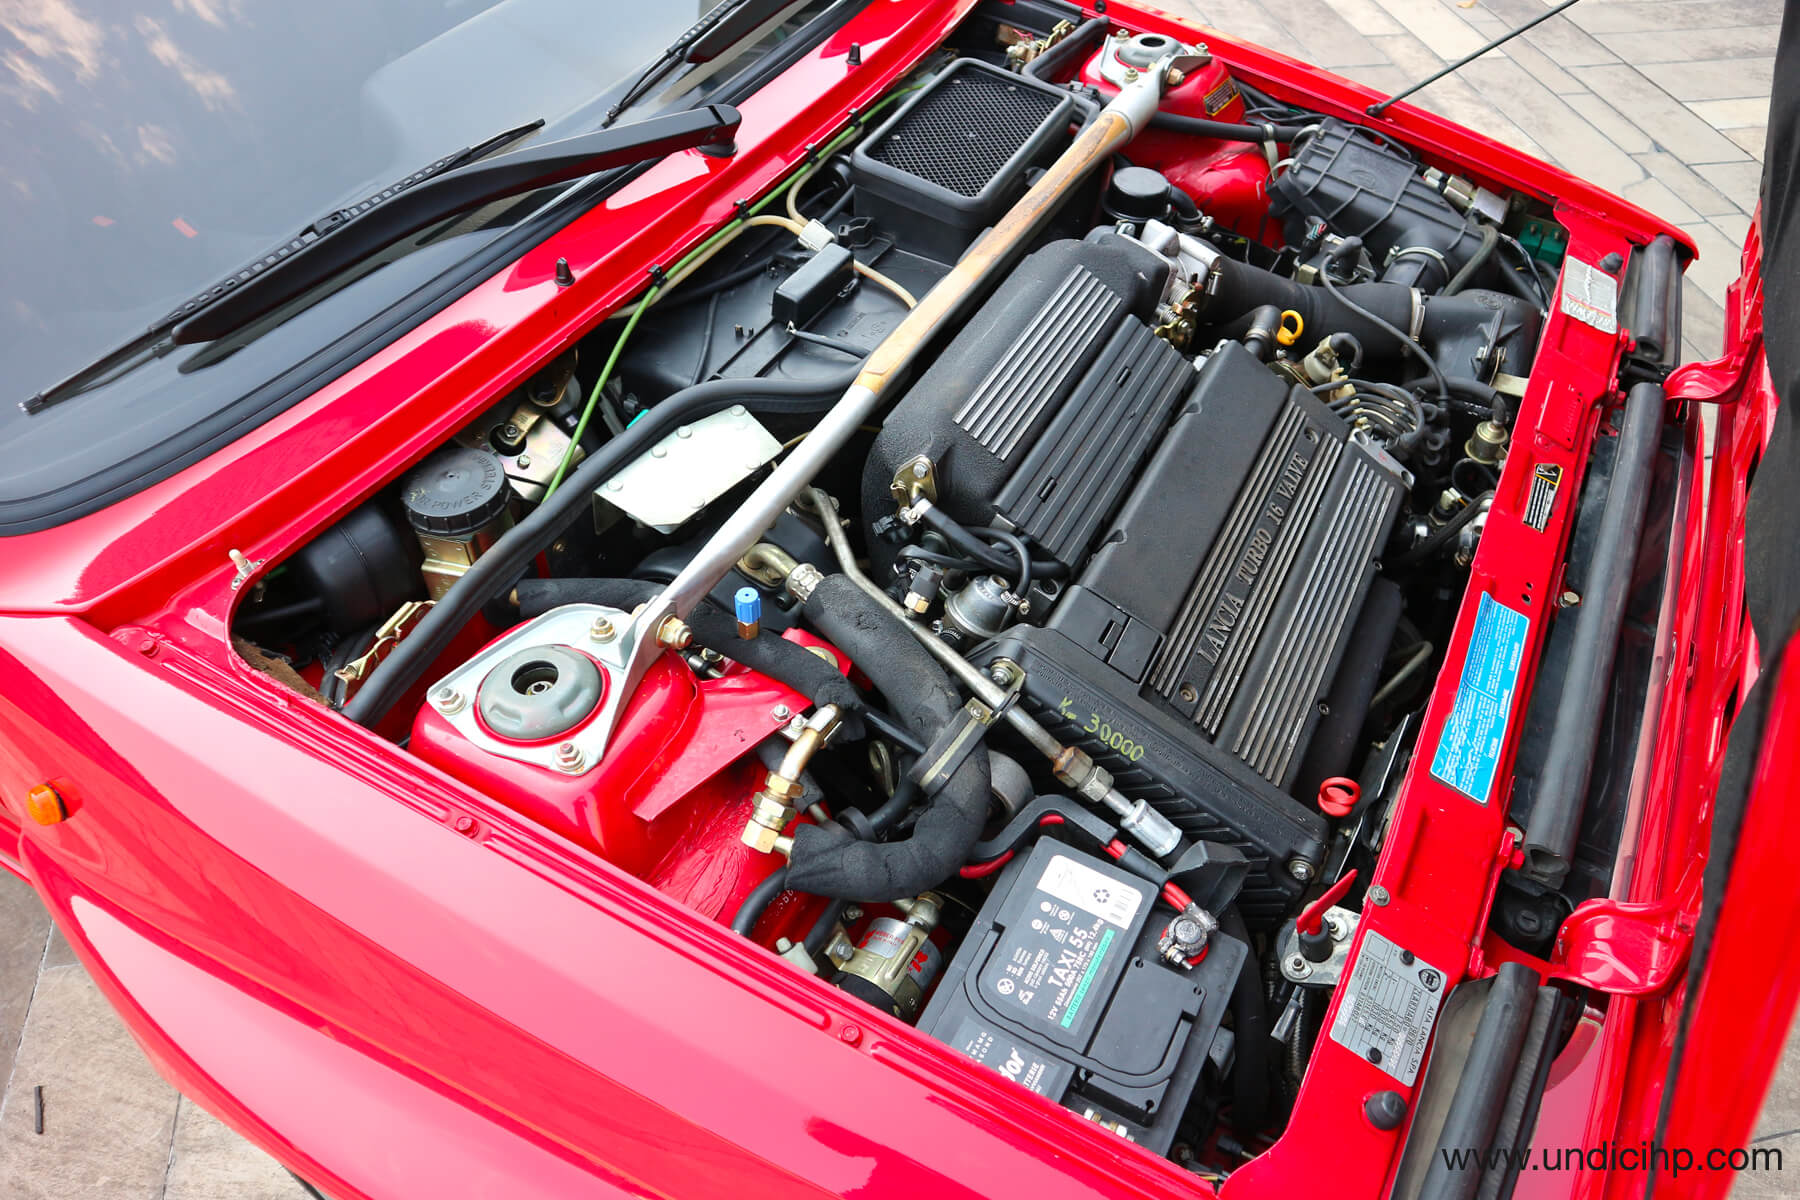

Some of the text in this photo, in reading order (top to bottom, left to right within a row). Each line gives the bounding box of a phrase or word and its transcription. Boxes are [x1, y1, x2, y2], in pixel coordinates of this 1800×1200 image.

[1197, 451, 1310, 666] LANCIA TURBO 16 VALVE
[1047, 949, 1078, 987] TAXI
[1068, 926, 1089, 949] 55
[1047, 1006, 1058, 1020] 12V
[1424, 1005, 1435, 1023] ALFA
[1415, 1026, 1428, 1055] LANCIA
